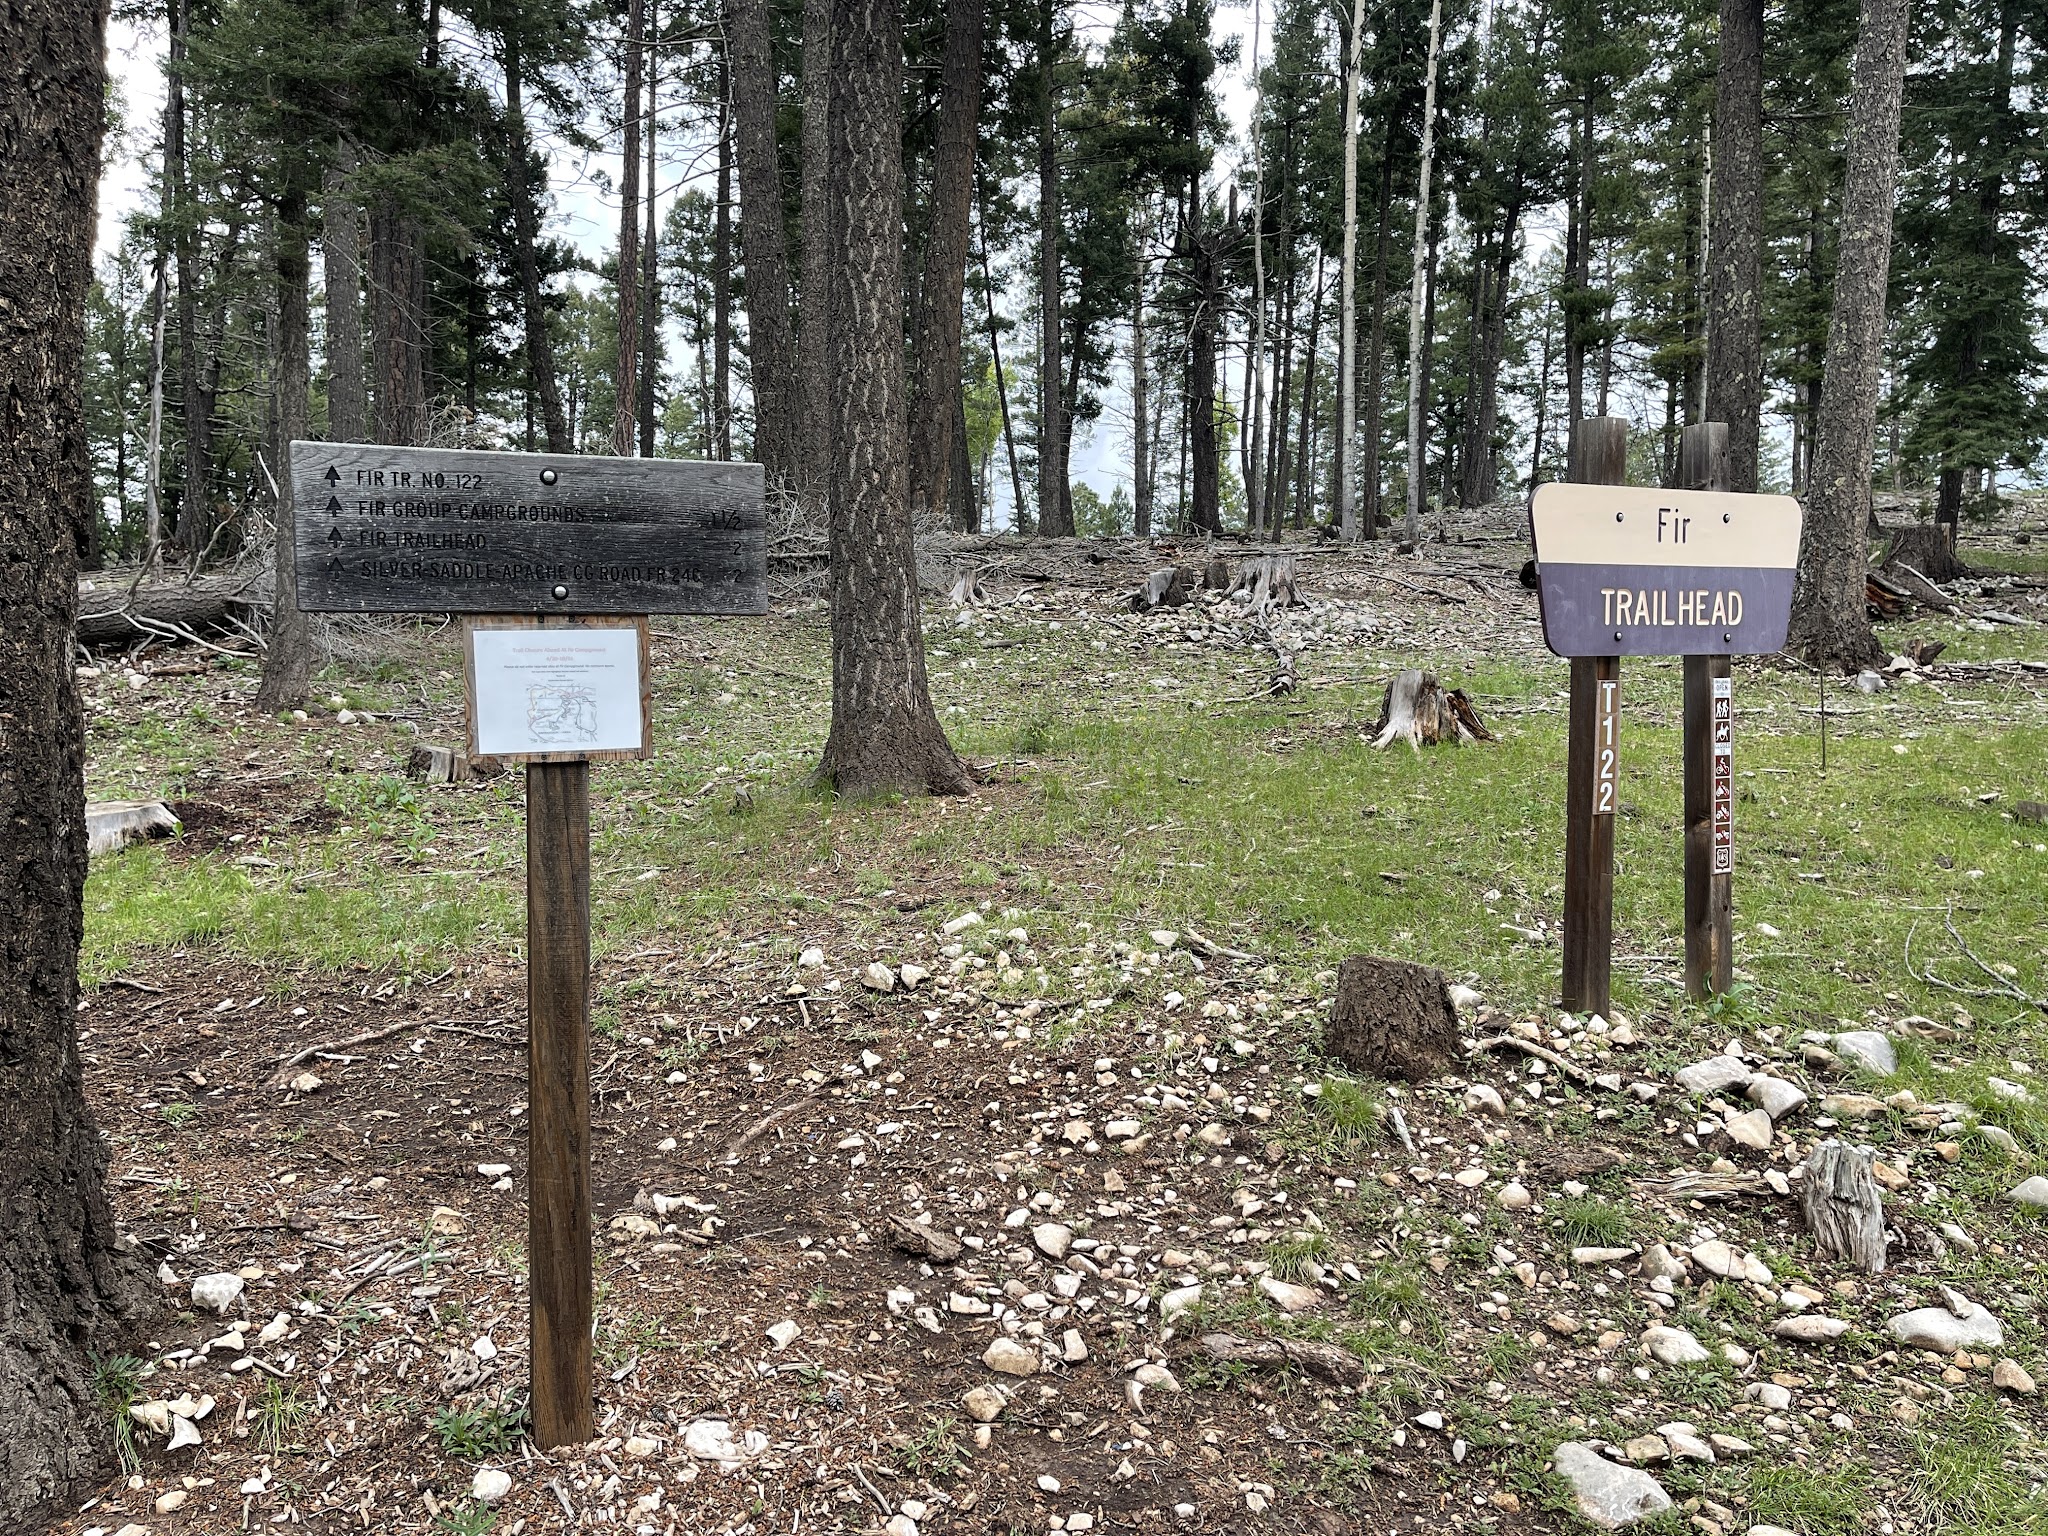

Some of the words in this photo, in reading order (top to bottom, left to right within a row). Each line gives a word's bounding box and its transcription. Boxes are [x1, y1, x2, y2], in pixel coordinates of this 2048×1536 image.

[357, 470, 384, 486] FIR
[390, 471, 416, 488] TR.
[422, 472, 450, 489] NO.
[456, 474, 483, 490] 122
[358, 500, 386, 517] FIR
[392, 501, 451, 518] GROUP
[459, 503, 584, 522] CAMPGROUNDS
[1657, 507, 1691, 544] Fir
[360, 531, 387, 547] FIR
[394, 531, 486, 549] TRAILHEAD
[733, 541, 742, 556] 2
[573, 564, 594, 581] CG
[647, 566, 666, 582] FR
[733, 568, 743, 584] 2
[1600, 588, 1743, 626] TRAILHEAD
[1716, 684, 1728, 692] OPEN
[1599, 682, 1617, 812] T122
